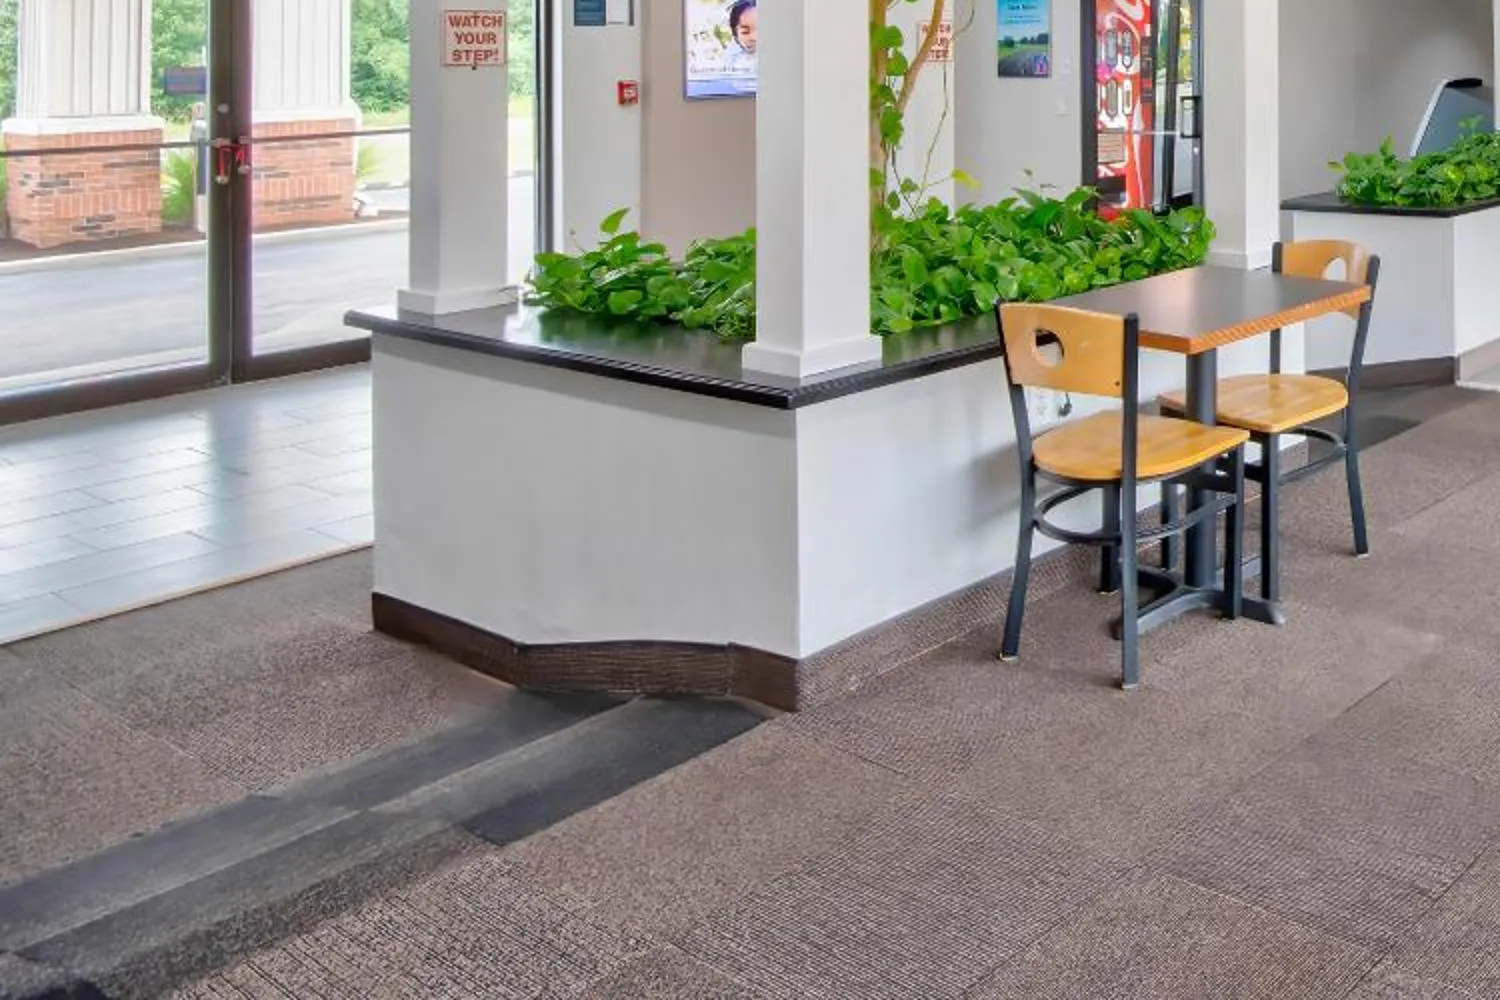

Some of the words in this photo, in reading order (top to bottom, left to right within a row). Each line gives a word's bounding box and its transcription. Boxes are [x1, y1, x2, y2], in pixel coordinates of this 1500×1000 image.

[448, 15, 502, 27] WATCH
[454, 32, 496, 44] YOUR
[452, 49, 498, 61] STEP!
